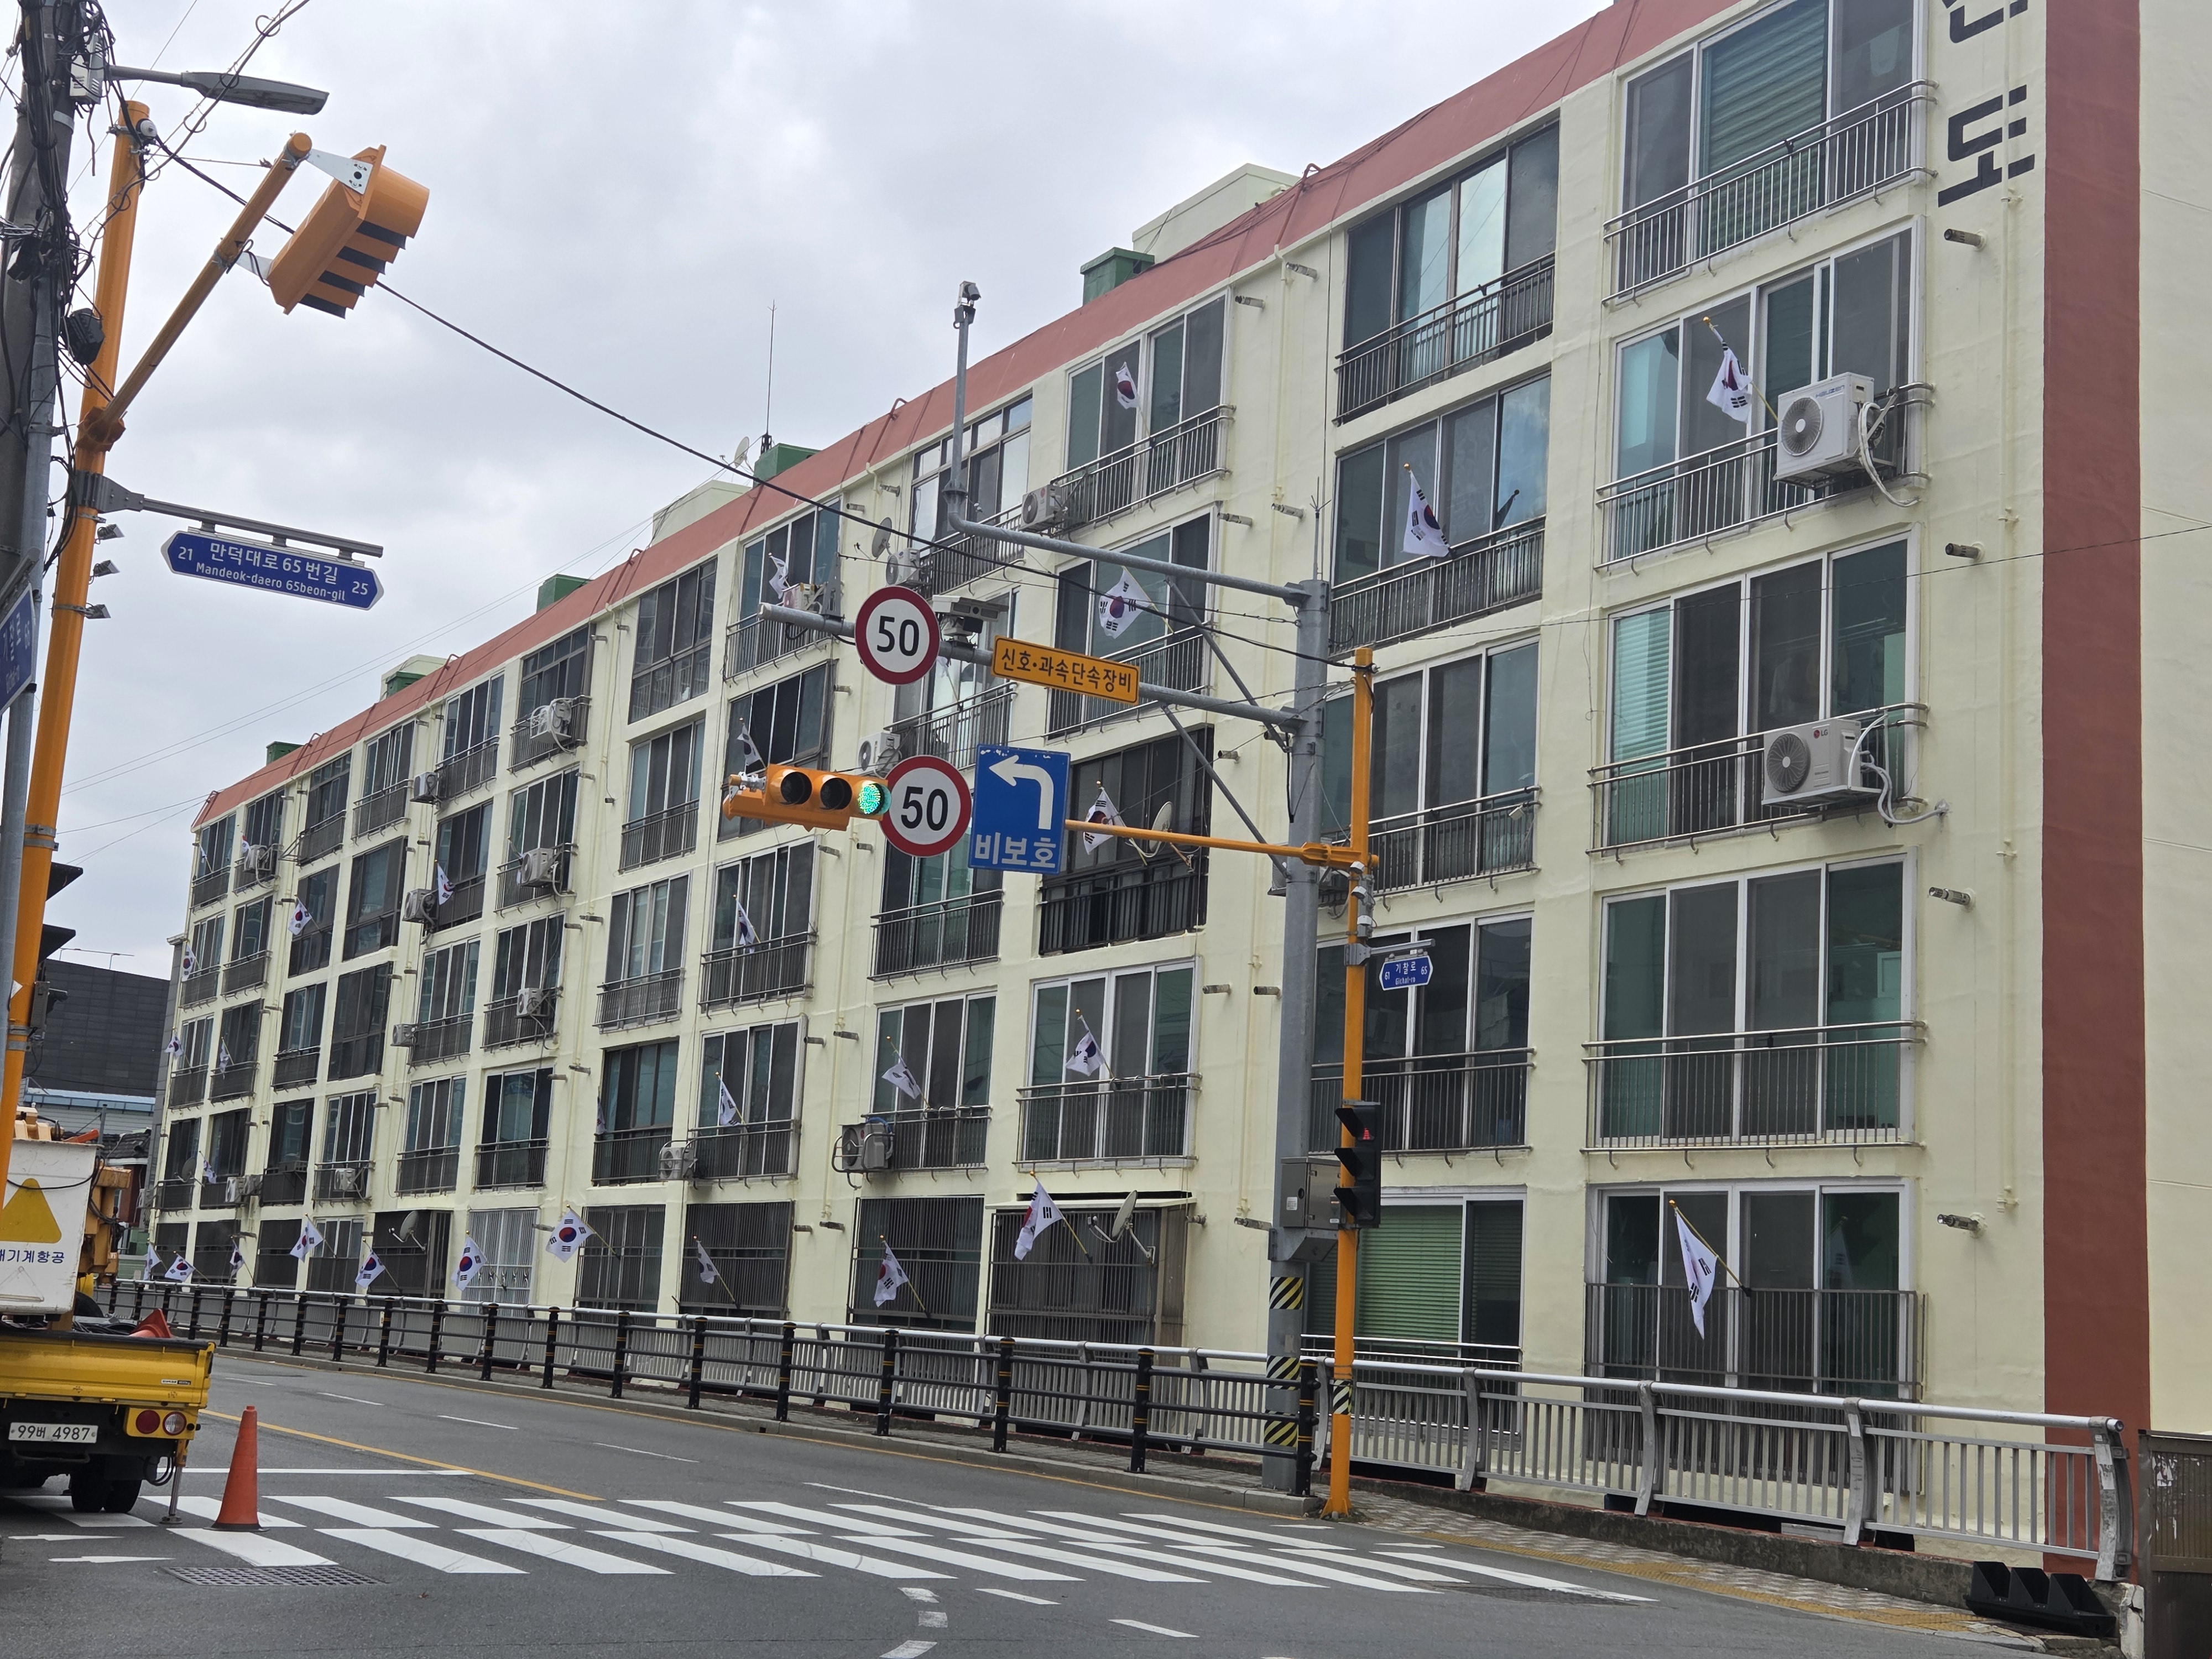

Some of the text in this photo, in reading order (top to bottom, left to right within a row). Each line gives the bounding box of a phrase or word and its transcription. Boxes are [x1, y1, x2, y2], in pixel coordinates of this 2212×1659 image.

[178, 546, 192, 561] 21
[196, 562, 346, 601] Mandeok-daero 65beon-gil
[352, 581, 369, 596] 25
[876, 616, 920, 656] 50
[901, 786, 948, 831] 50
[974, 832, 1056, 868] 비보호
[1384, 971, 1390, 980] 61
[1395, 961, 1417, 975] 기찰로
[1421, 966, 1428, 975] 65
[1395, 976, 1416, 985] Gichal-ro
[18, 1425, 91, 1441] 99버 4987
